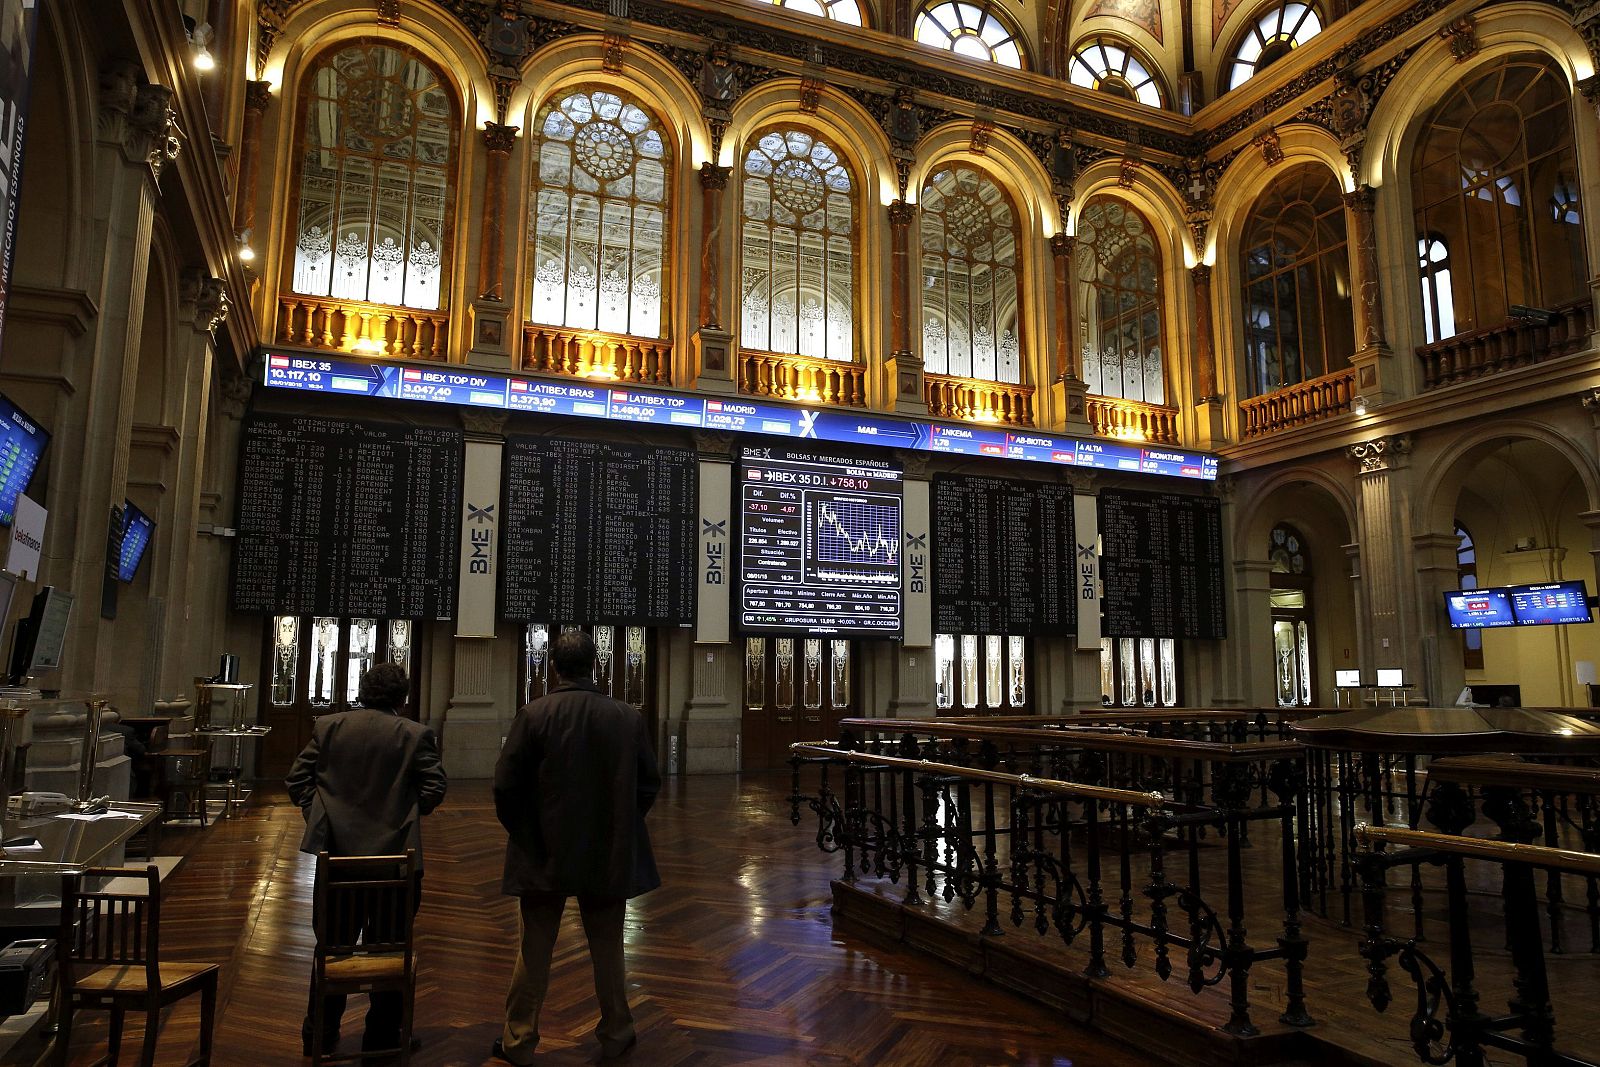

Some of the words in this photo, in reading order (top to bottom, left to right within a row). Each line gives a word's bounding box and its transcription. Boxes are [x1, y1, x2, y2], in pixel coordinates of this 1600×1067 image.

[1, 200, 16, 284] MERCADOS
[292, 359, 316, 370] IBEX
[319, 363, 331, 371] 35
[423, 373, 446, 383] IBEX
[448, 376, 468, 384] TOP
[470, 378, 487, 387] DIV
[403, 384, 452, 396] 3.047,40
[529, 384, 567, 395] LATIBEX
[569, 388, 594, 398] BRAS
[629, 395, 666, 406] LATIBEX
[667, 398, 684, 407] TOP
[723, 404, 756, 415] MADRID
[293, 418, 350, 429] COTIZACIONES
[297, 425, 326, 433] ULTIMO
[248, 427, 283, 435] MERCADO
[414, 428, 460, 438] 08/01/2015
[857, 426, 878, 435] MAB
[549, 440, 599, 450] COTIZACIONES
[1015, 436, 1052, 447] AB-BIOTICS
[743, 448, 761, 456] BME
[1085, 444, 1103, 452] ALTIA
[819, 456, 853, 465] MERCADOS
[855, 459, 889, 468] ESPAÑOLES
[356, 474, 394, 482] CARBURES
[772, 471, 796, 483] IBEX
[799, 474, 810, 484] 35
[813, 475, 828, 486] D.I.
[837, 478, 869, 489] 758,10
[872, 471, 898, 479] MADRID
[469, 528, 489, 575] BME
[706, 542, 723, 585] BME
[910, 553, 923, 594] BME
[1082, 563, 1094, 600] BME
